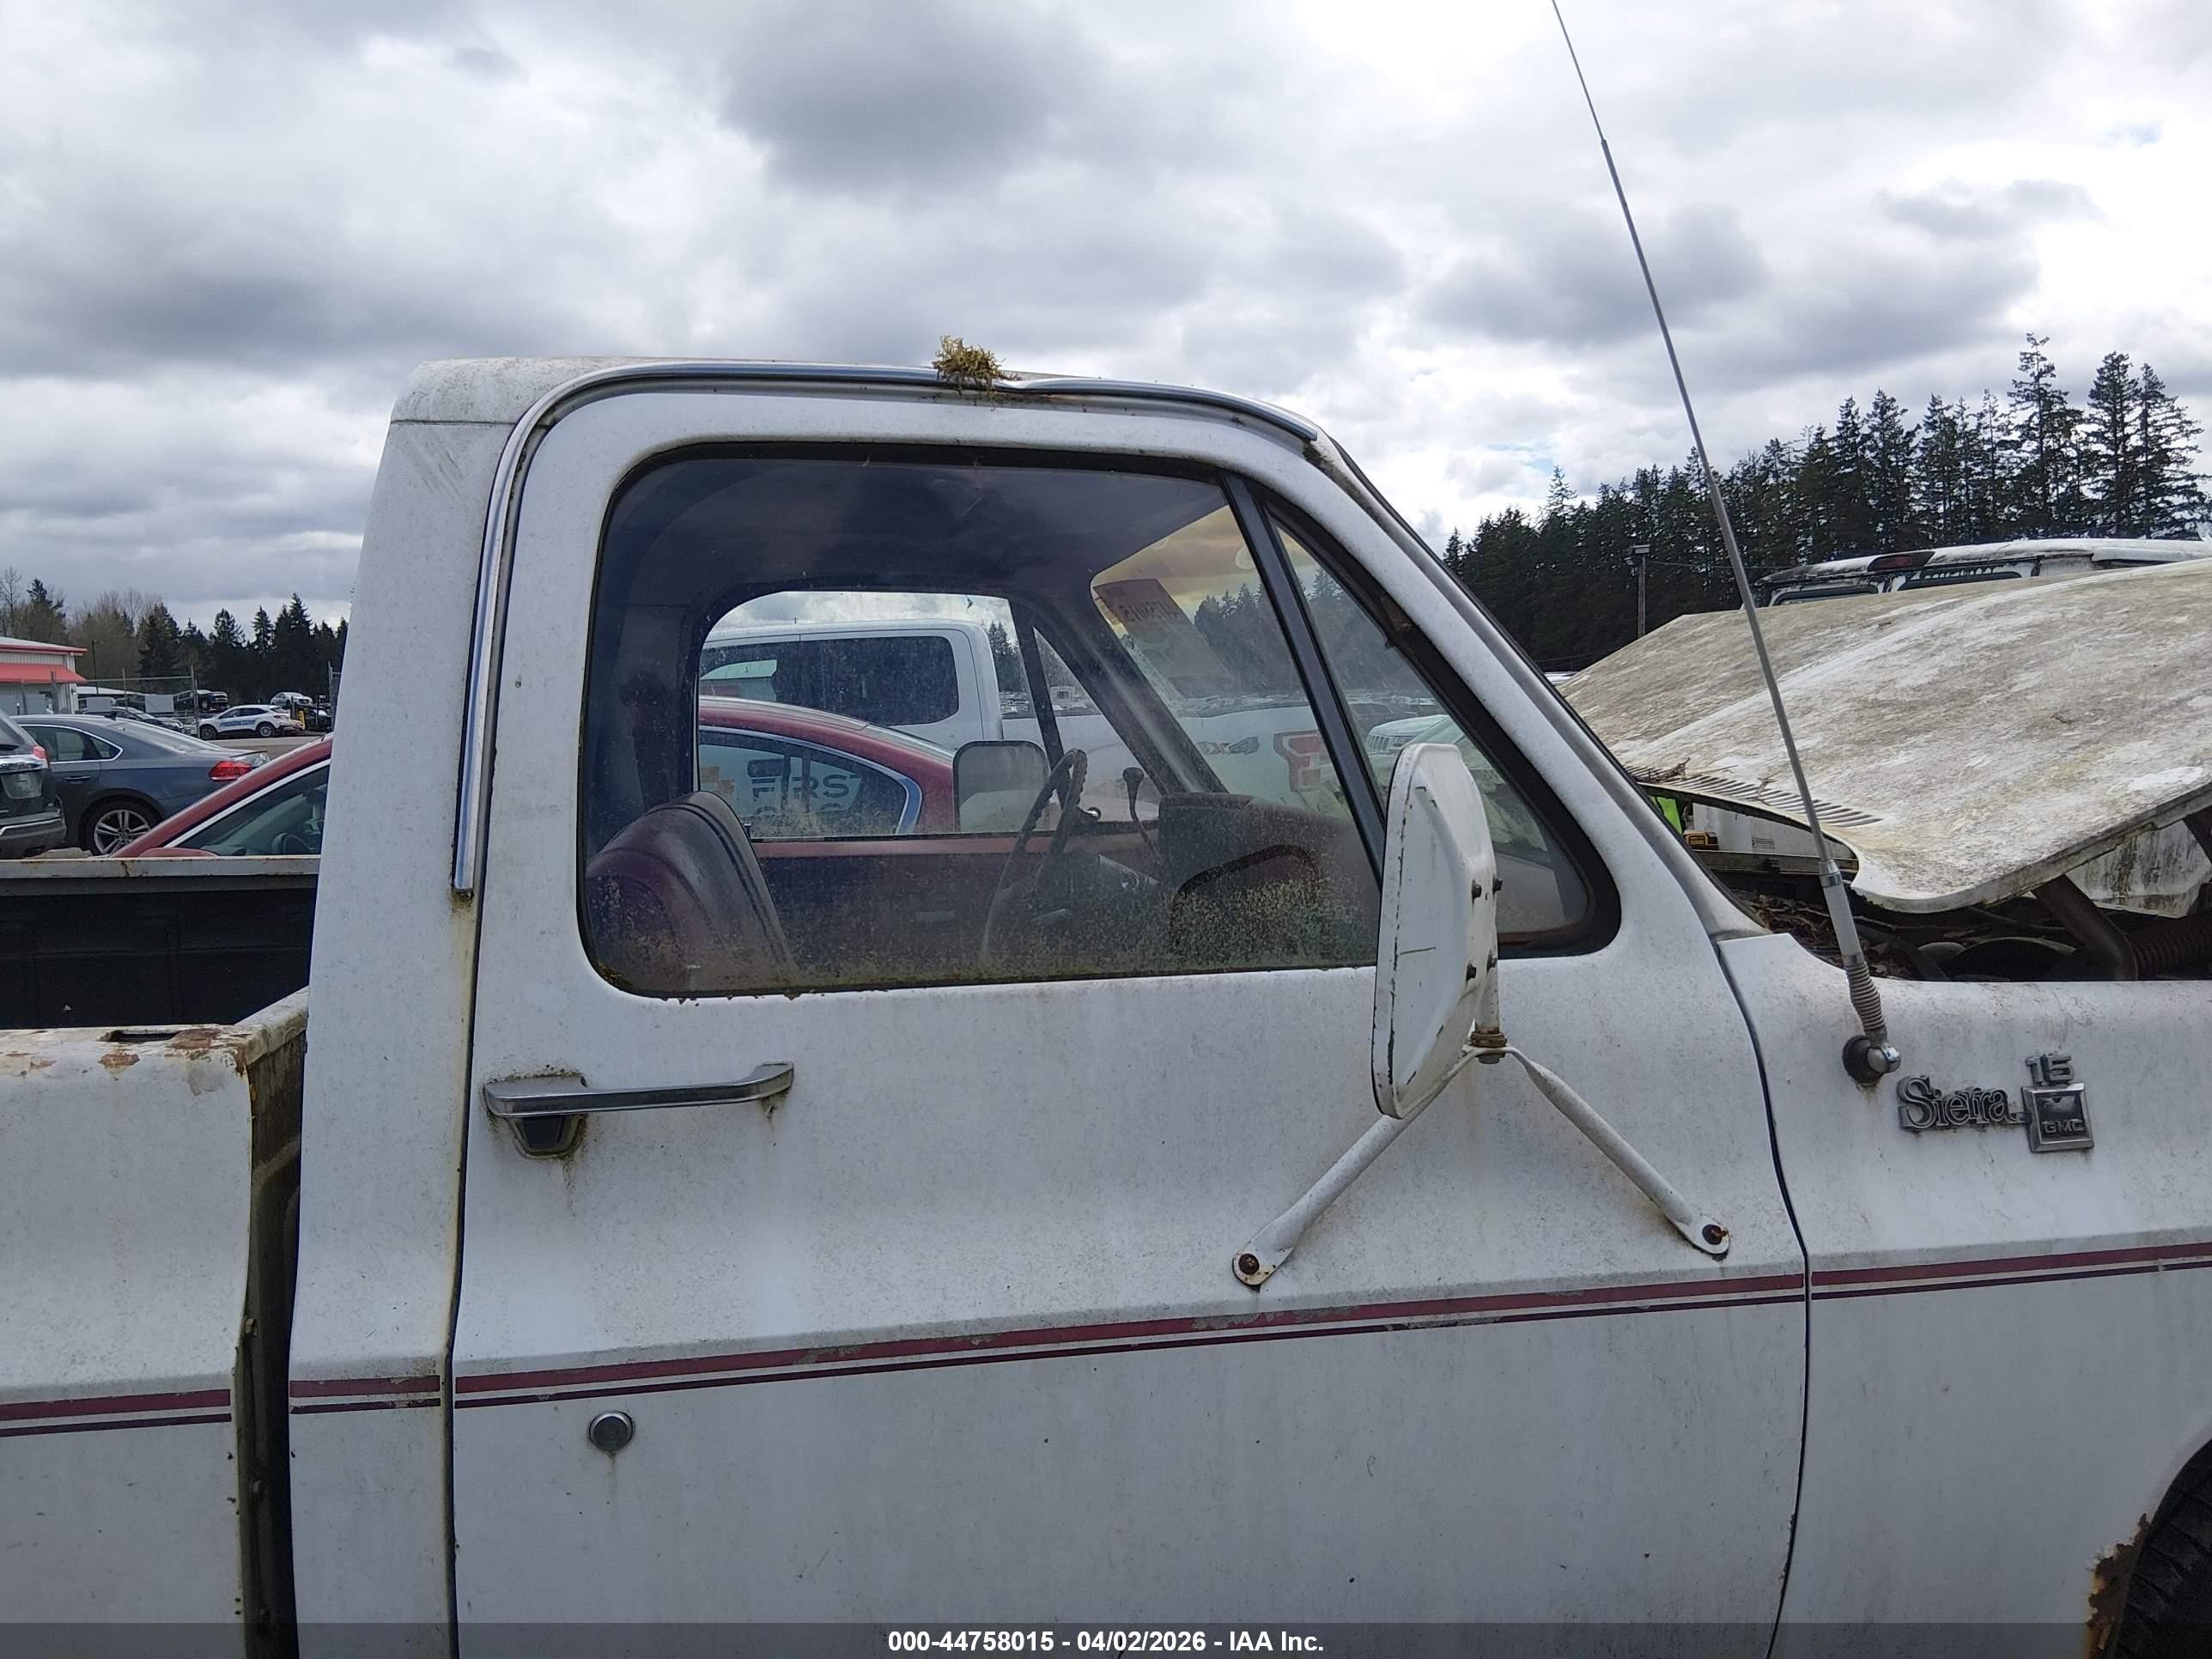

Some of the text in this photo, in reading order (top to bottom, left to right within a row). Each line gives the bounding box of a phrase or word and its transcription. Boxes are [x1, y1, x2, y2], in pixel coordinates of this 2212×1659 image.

[2026, 1054, 2075, 1086] 15
[1897, 1075, 2024, 1129] Sierra
[2042, 1118, 2086, 1133] GMC
